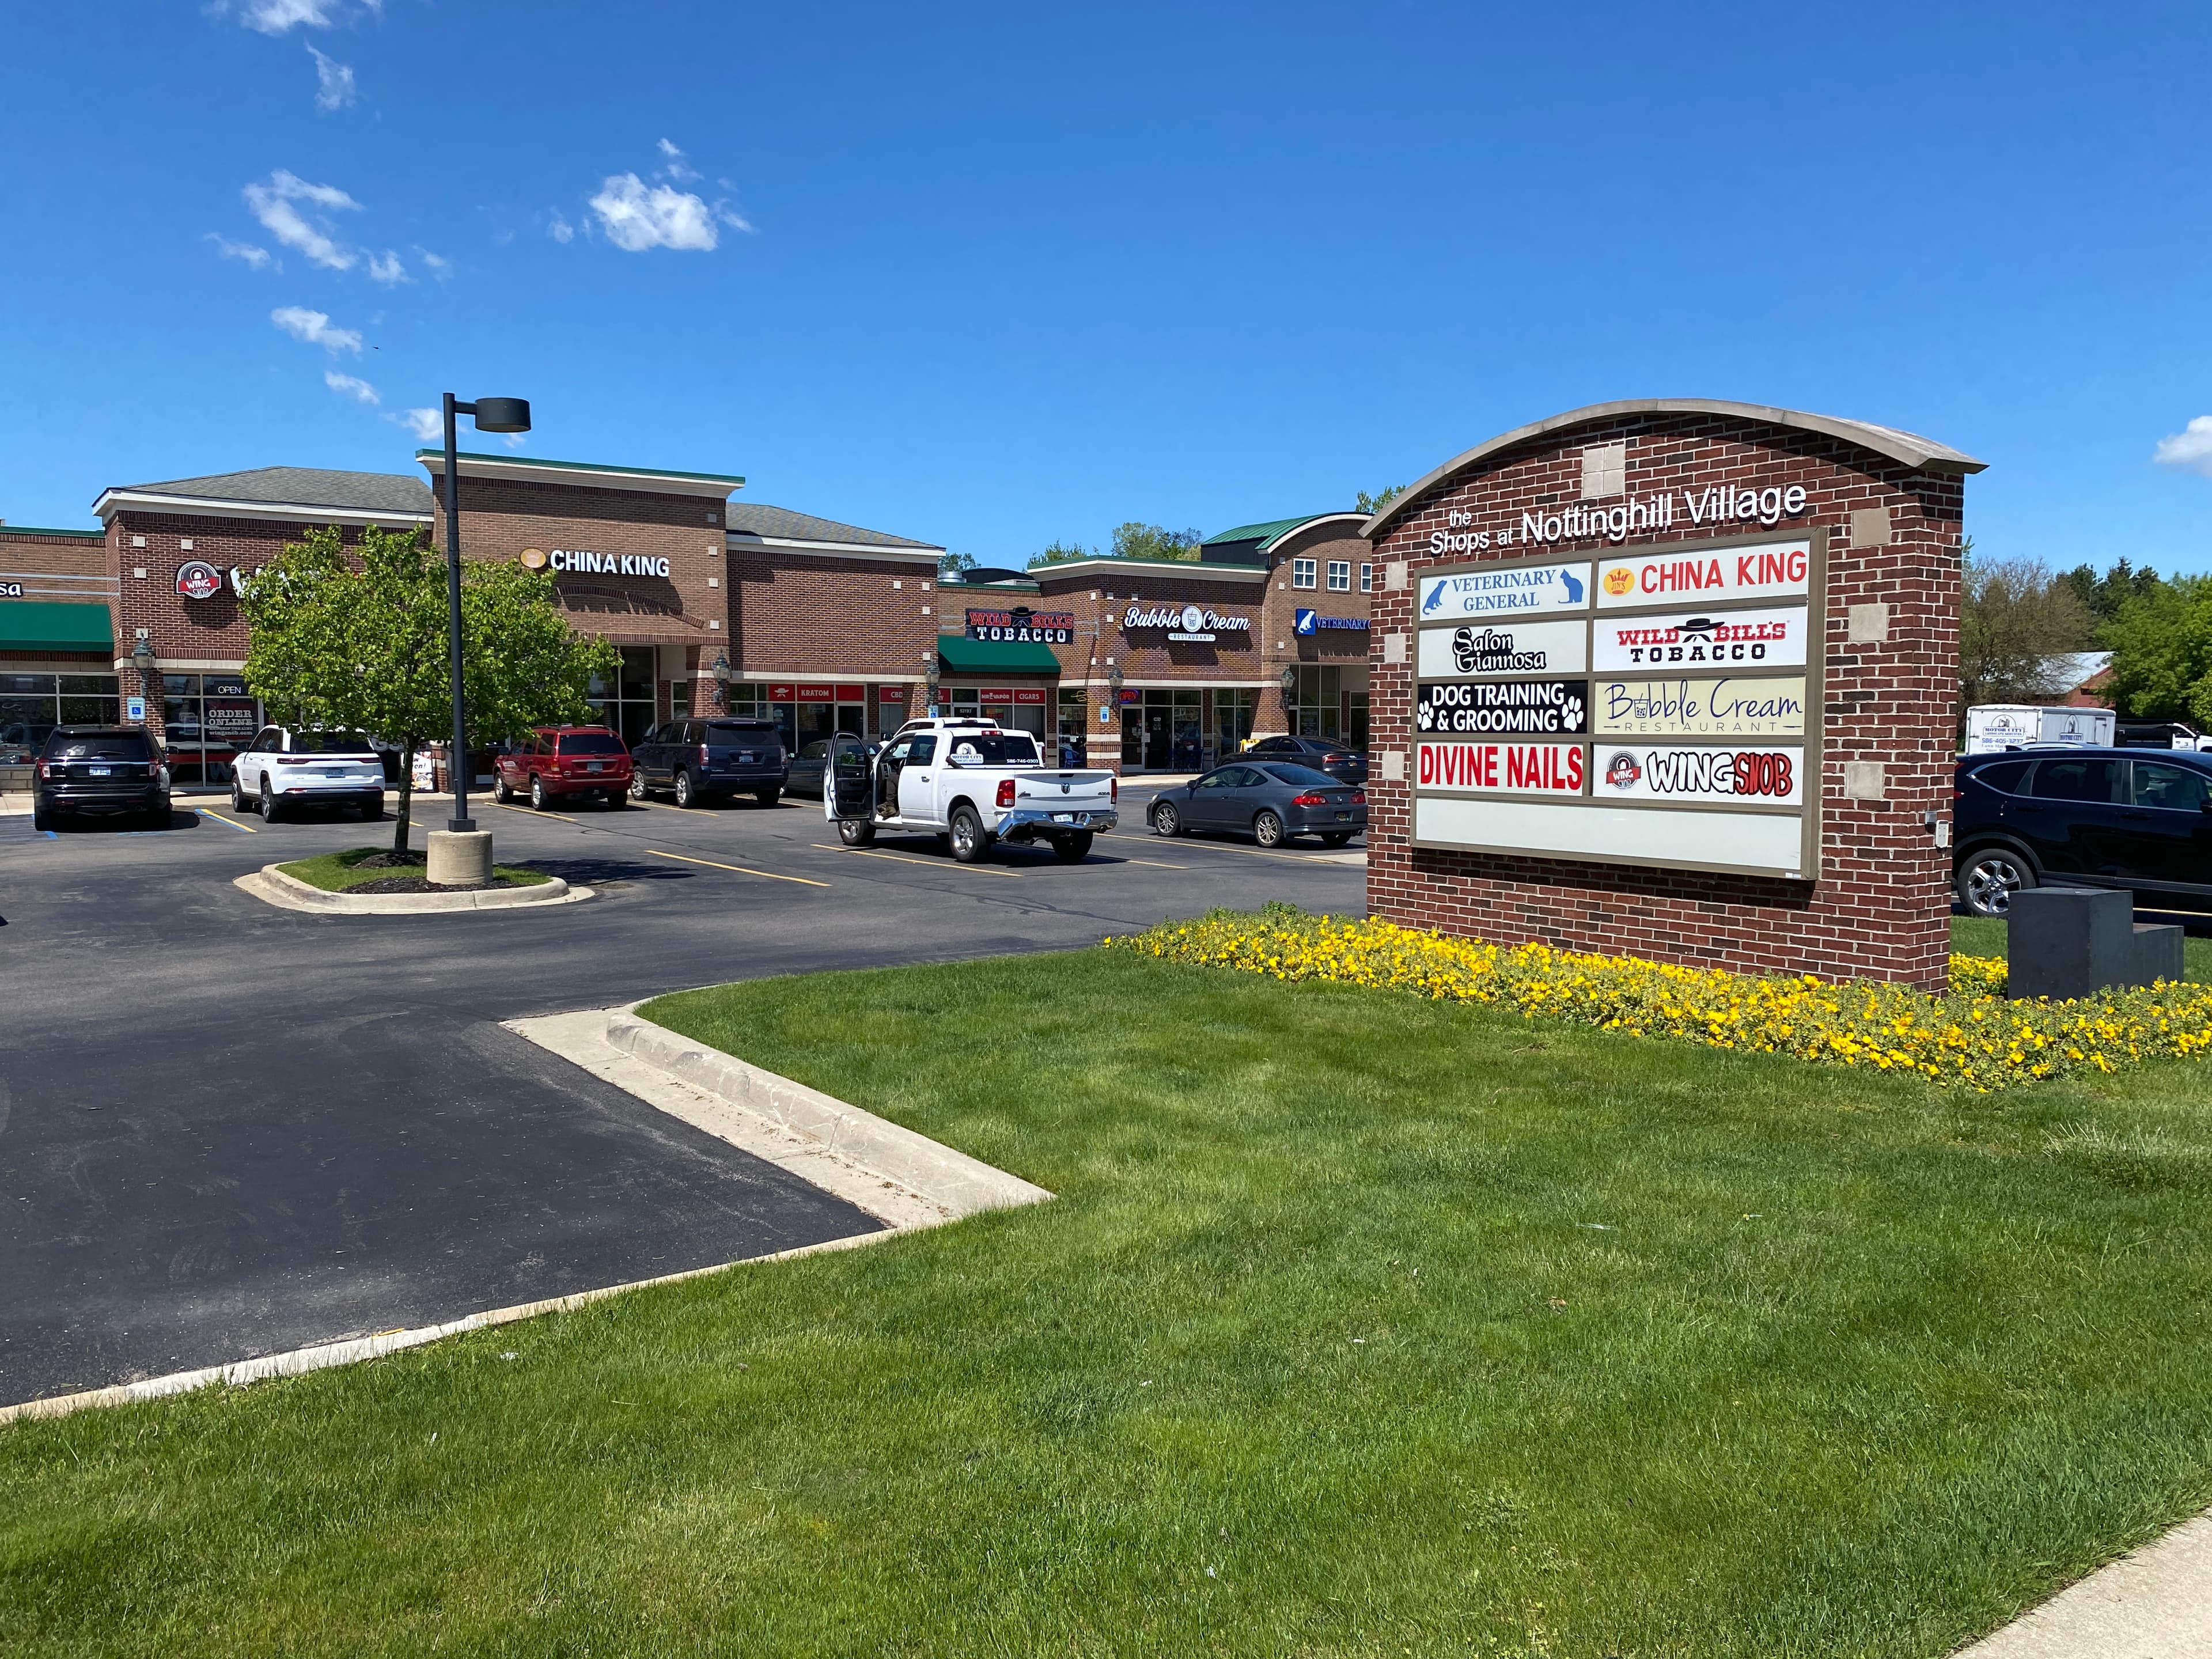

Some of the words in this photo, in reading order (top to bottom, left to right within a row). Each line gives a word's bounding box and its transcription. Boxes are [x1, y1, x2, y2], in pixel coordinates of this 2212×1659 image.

[1430, 531, 1490, 555] Shops
[1498, 528, 1513, 545] at
[1522, 493, 1672, 543] Nottinghill
[1684, 484, 1806, 525] Village
[1449, 510, 1472, 527] the
[550, 550, 618, 574] CHINA
[621, 555, 669, 577] KING
[1641, 559, 1724, 594] CHINA
[1737, 550, 1806, 586] KING
[186, 579, 211, 590] WING
[1452, 570, 1557, 592] VETERINARY
[1464, 592, 1540, 611] GENERAL
[969, 612, 1011, 627] WILD
[1031, 613, 1073, 629] BILL'S
[1124, 607, 1181, 628] Bubble
[1203, 611, 1251, 631] Cream
[1316, 617, 1367, 630] VETERINARY
[977, 627, 1066, 643] TOBACCO
[1453, 627, 1514, 654] Salon
[1617, 627, 1680, 646] WILD
[1714, 621, 1786, 643] BILL'S
[1456, 649, 1547, 673] Giannosa
[1631, 643, 1766, 662] TOBACCO
[1120, 692, 1136, 700] OPEN
[1432, 685, 1471, 706] DOG
[1475, 683, 1565, 706] TRAINING
[1710, 678, 1803, 718] Cream
[209, 710, 252, 718] ORDER
[1437, 710, 1450, 730] &
[1453, 709, 1558, 731] GROOMING
[1625, 722, 1777, 732] RESTAURANT
[1421, 745, 1498, 786] DIVINE
[1507, 747, 1583, 790] NAILS
[1613, 769, 1634, 781] WING
